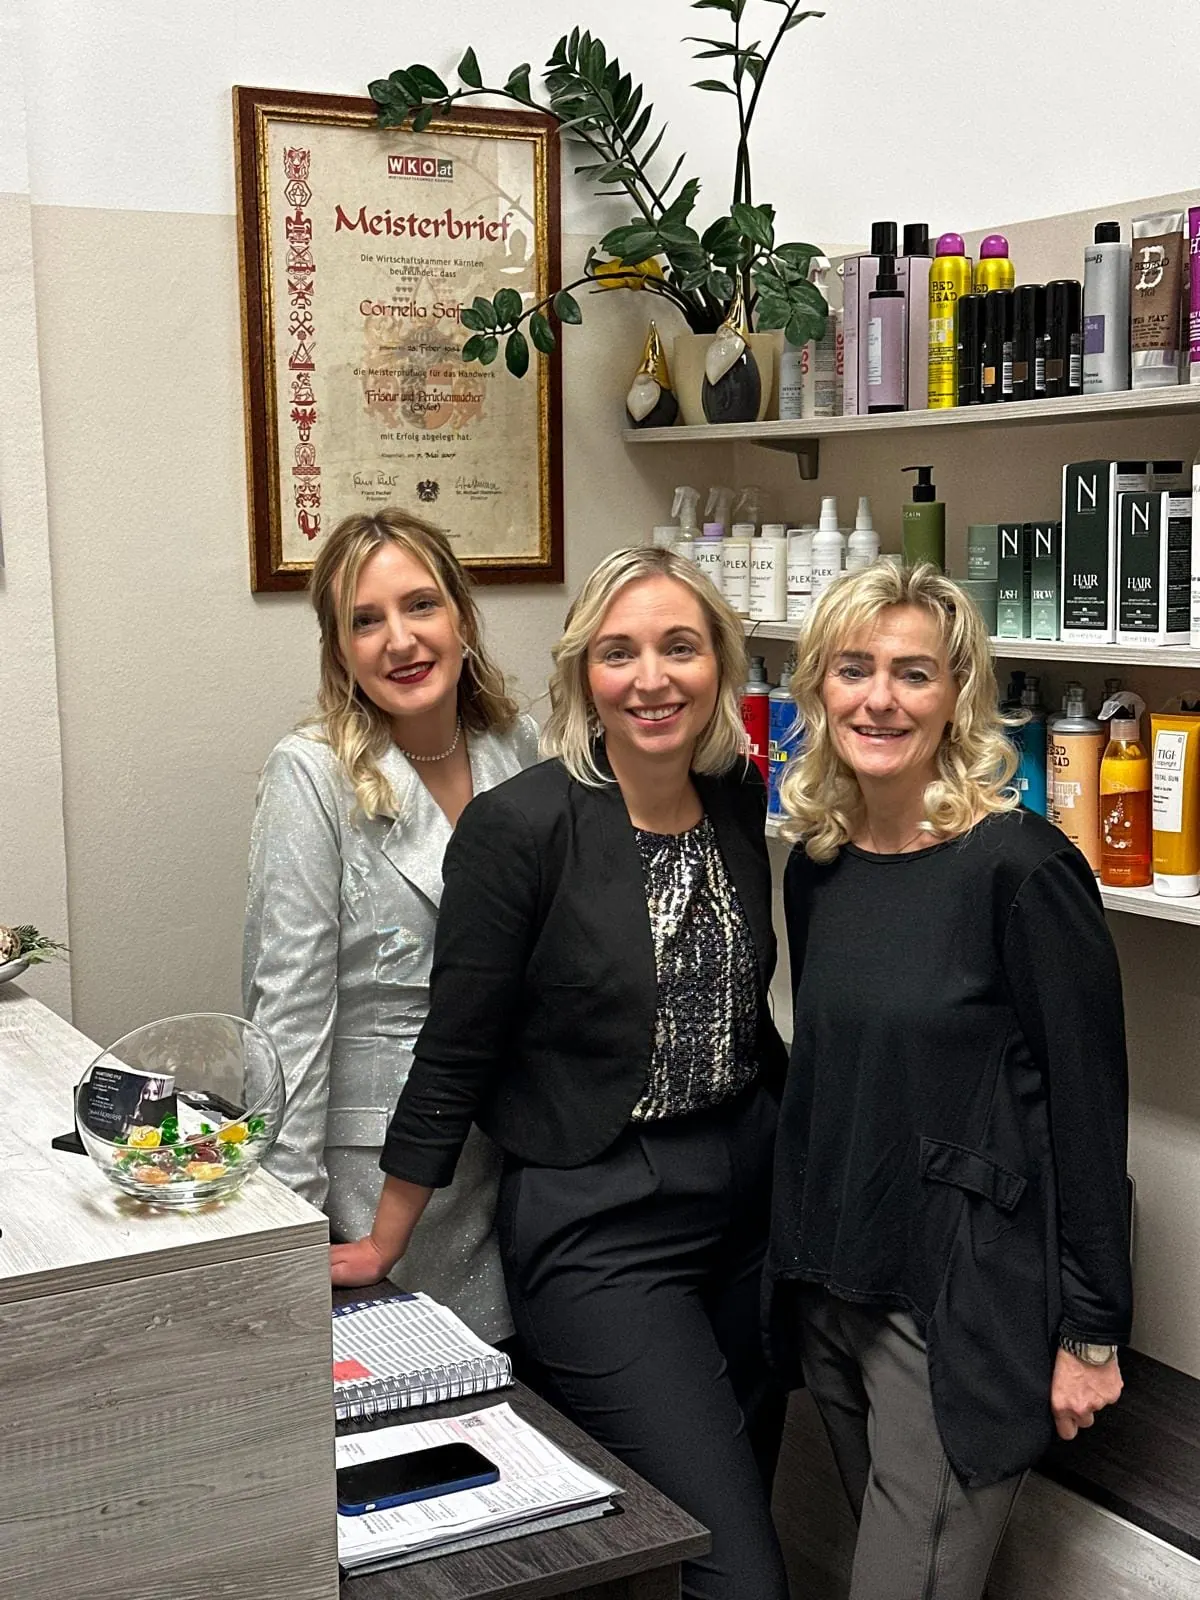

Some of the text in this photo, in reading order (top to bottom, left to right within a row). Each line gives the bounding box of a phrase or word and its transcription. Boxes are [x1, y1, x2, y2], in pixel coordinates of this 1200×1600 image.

[335, 204, 514, 242] Meisterbrief
[360, 254, 484, 268] Die Wirtschaftskammer Kärnten
[440, 269, 457, 278] dass
[932, 281, 954, 291] BED
[930, 291, 958, 303] HEAD
[359, 300, 464, 324] Cornelia Saf
[353, 368, 366, 376] die
[429, 368, 441, 377] für
[443, 370, 456, 378] das
[458, 370, 495, 379] Handwerk
[380, 433, 393, 441] mit
[396, 433, 419, 442] Erfolg
[421, 433, 455, 442] abgelegt
[1077, 474, 1097, 513] N
[1131, 501, 1150, 536] N
[1002, 528, 1018, 559] N
[1035, 527, 1052, 558] N
[1073, 574, 1099, 586] HAIR
[1127, 577, 1152, 589] HAIR
[1000, 590, 1018, 600] LASH
[1033, 590, 1054, 600] BROW
[1053, 757, 1070, 767] EAD
